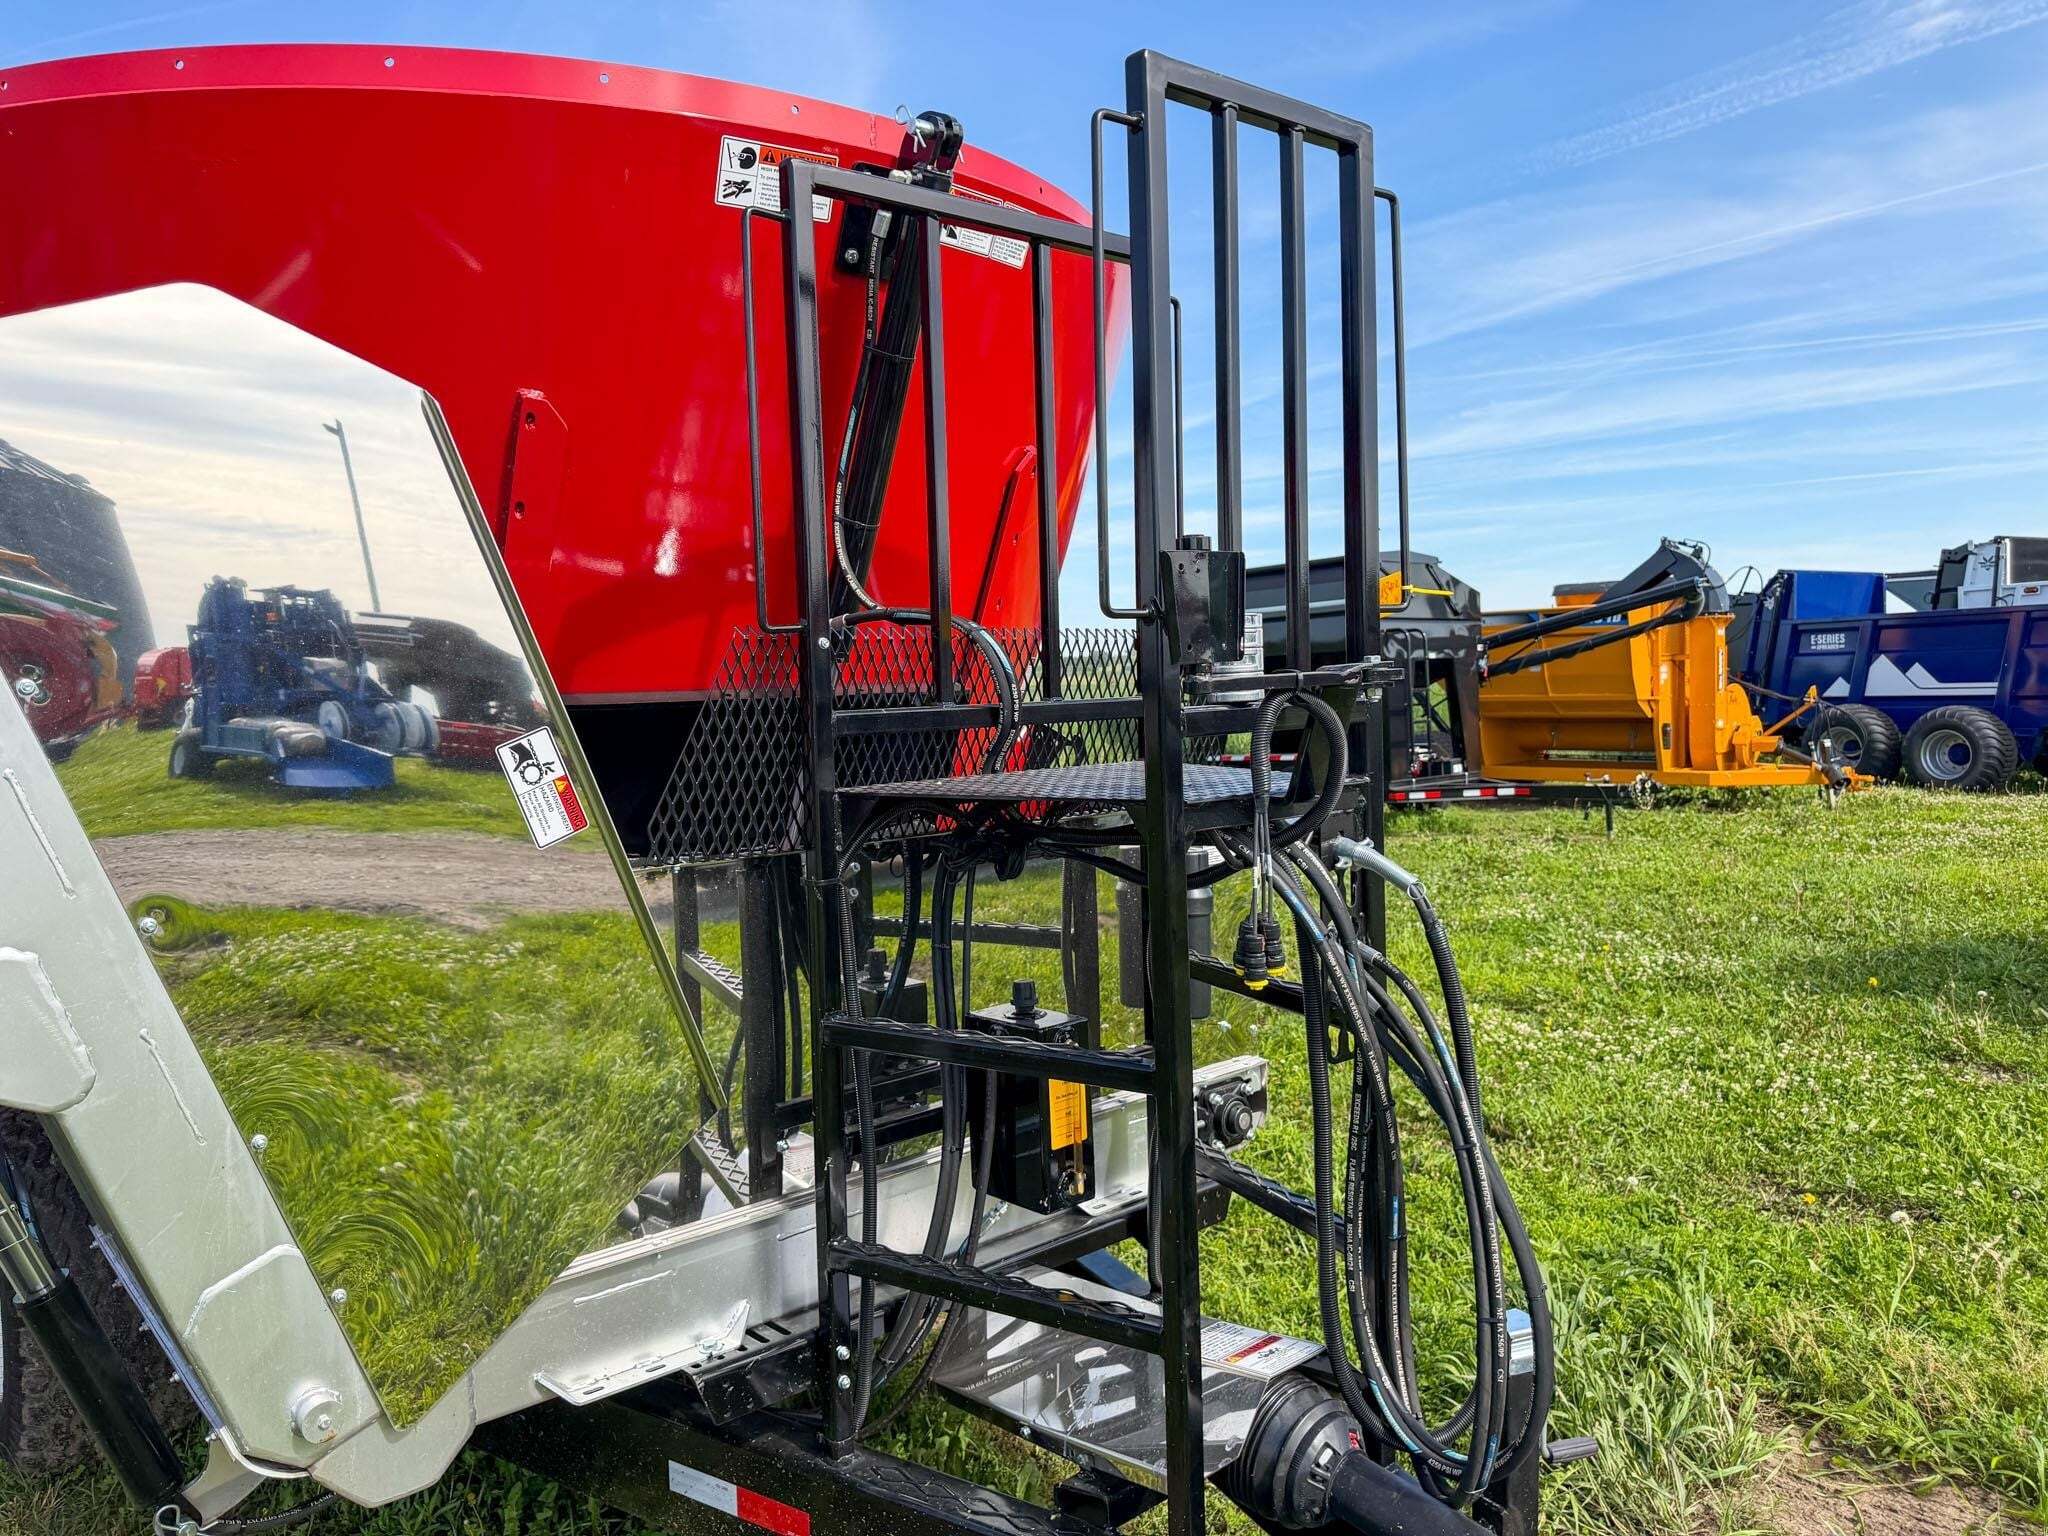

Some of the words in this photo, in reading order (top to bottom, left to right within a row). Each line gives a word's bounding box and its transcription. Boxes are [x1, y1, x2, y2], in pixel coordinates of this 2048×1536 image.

[869, 237, 878, 274] RESISTANT
[1811, 634, 1845, 645] E-SERIES
[1011, 683, 1019, 699] 4250
[1012, 711, 1020, 722] WP
[540, 787, 555, 813] HAZARD
[547, 783, 571, 832] ENTANGLEMENT
[562, 789, 583, 829] WARNING
[1332, 965, 1343, 978] PSI
[1337, 976, 1348, 990] WP
[1342, 988, 1361, 1020] EXCEEDS
[1366, 1051, 1380, 1074] FLAME
[1356, 1074, 1363, 1086] WP
[1371, 1073, 1392, 1107] RESISTANT
[1352, 1094, 1362, 1123] EXCEEDS
[1348, 1158, 1356, 1181] FLAME
[1346, 1182, 1354, 1218] RESISTANT
[1486, 1221, 1497, 1252] FLAME
[1490, 1253, 1503, 1300] RESISTANT
[1390, 1283, 1400, 1315] EXCEEDS
[1395, 1350, 1404, 1377] FLAME
[1495, 1368, 1506, 1385] CSI
[1440, 1464, 1453, 1474] PSI
